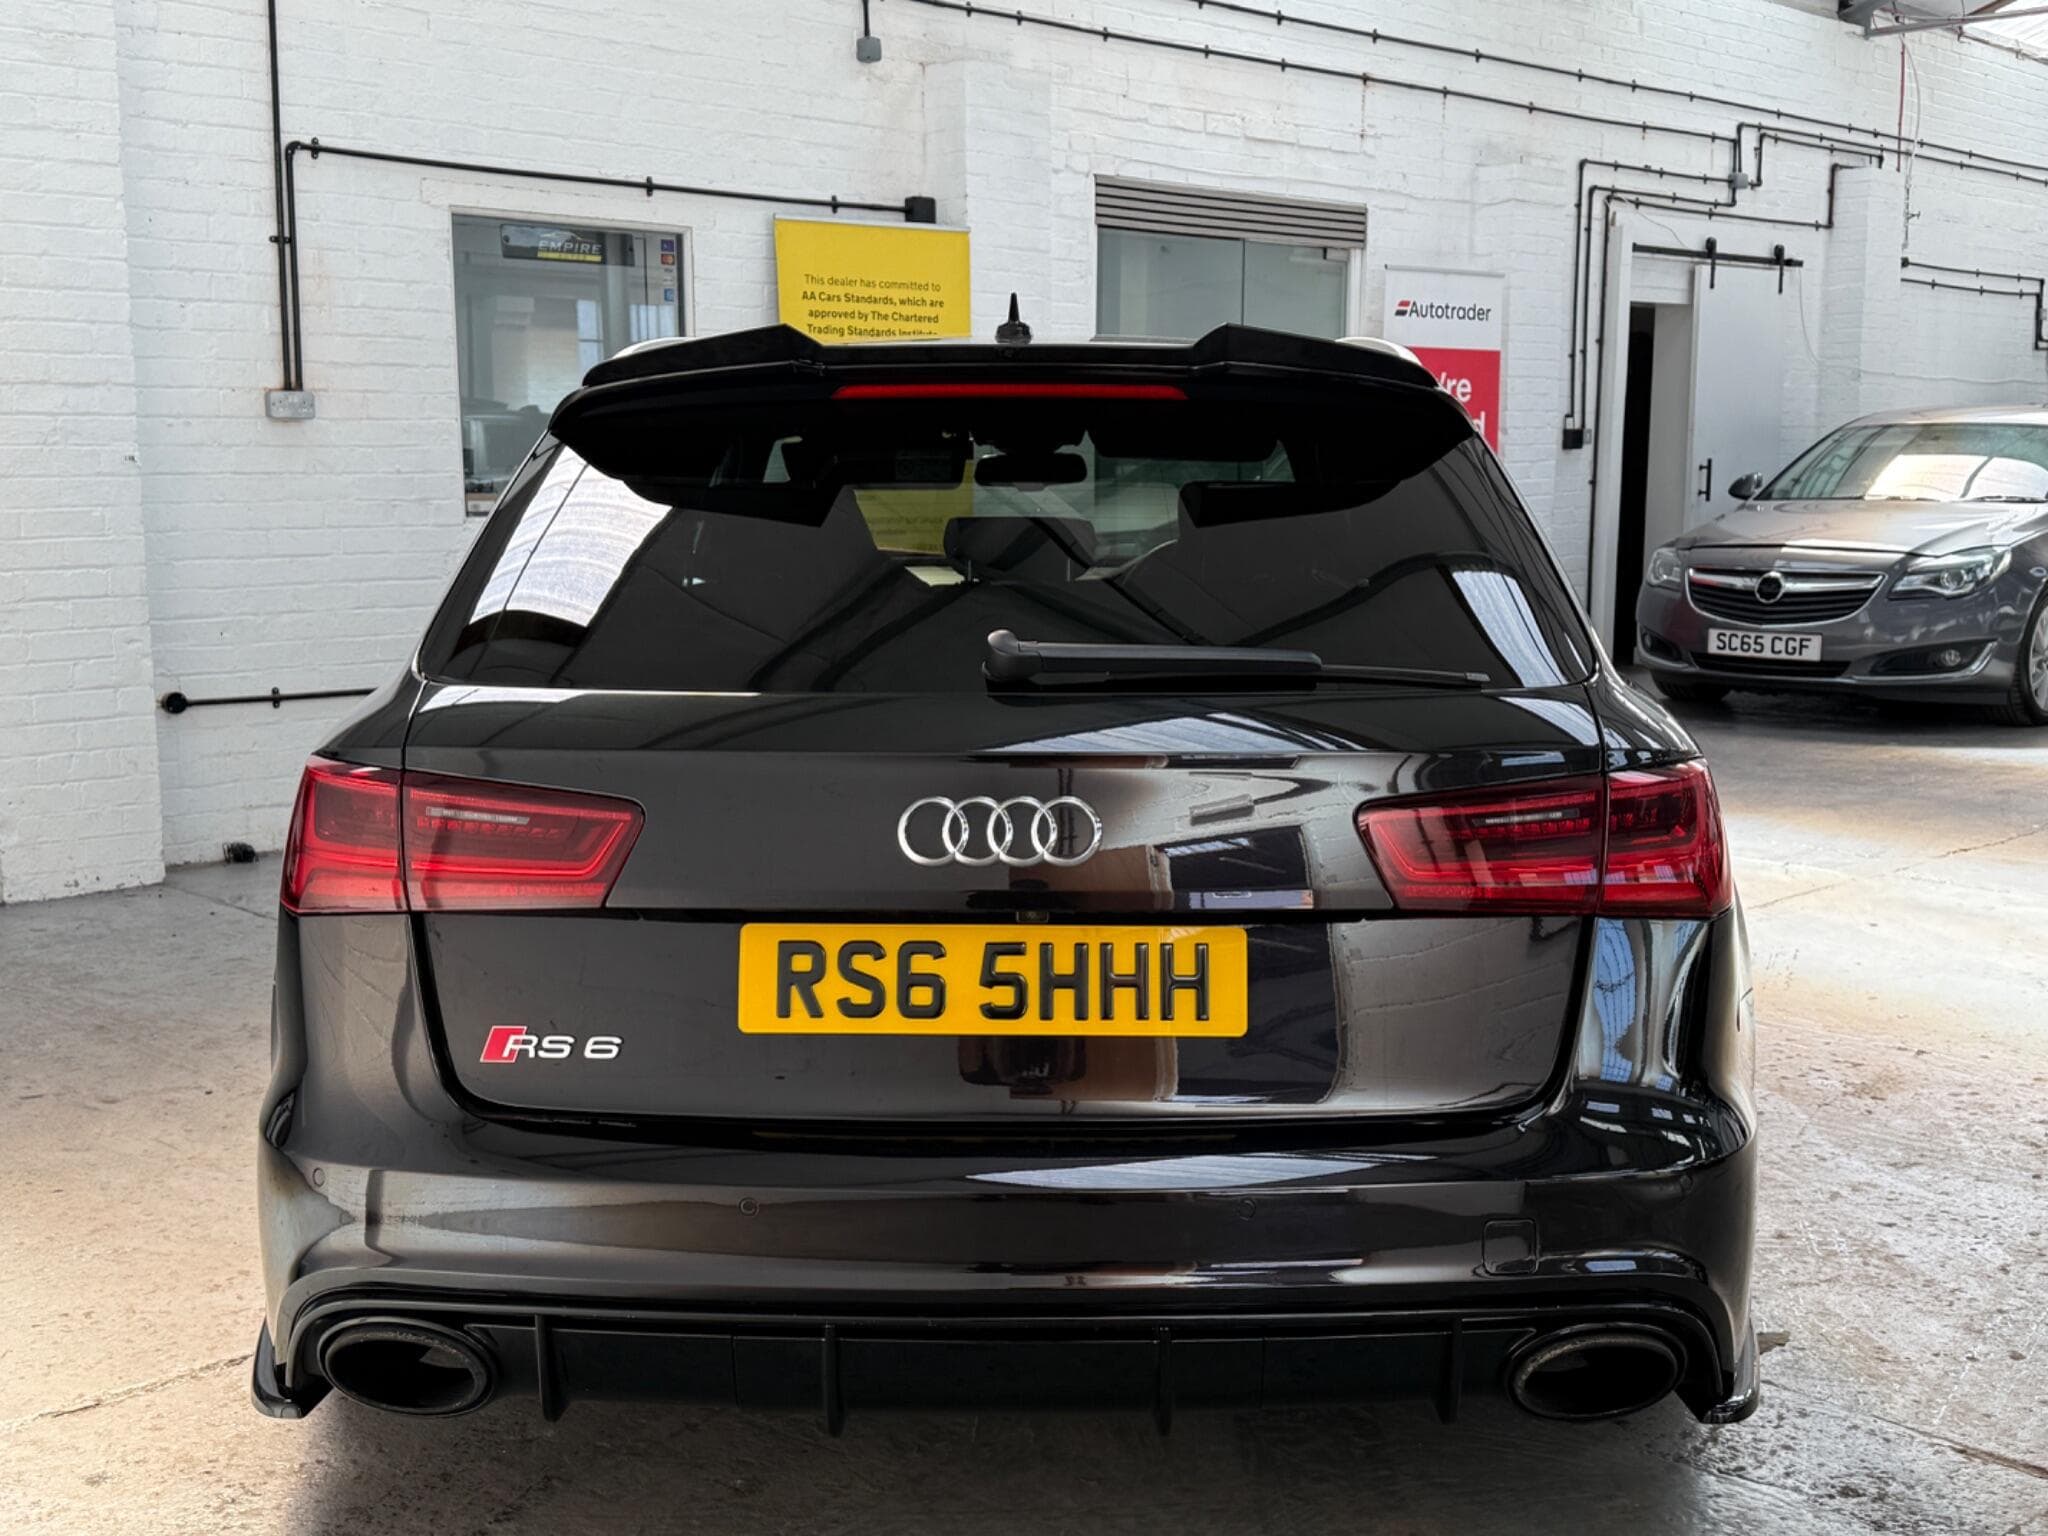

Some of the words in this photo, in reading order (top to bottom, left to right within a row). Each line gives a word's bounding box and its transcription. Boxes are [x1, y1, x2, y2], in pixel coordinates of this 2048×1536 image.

[539, 240, 602, 255] EMPIRE
[804, 274, 824, 285] This
[827, 276, 857, 287] dealer
[860, 278, 876, 288] has
[879, 280, 929, 292] committed
[931, 282, 941, 292] to
[802, 291, 816, 301] AA
[819, 292, 841, 302] Cars
[844, 293, 897, 306] Standards,
[899, 296, 927, 307] which
[929, 299, 944, 308] are
[808, 309, 855, 319] approved
[858, 310, 868, 321] by
[871, 311, 889, 321] The
[891, 312, 939, 323] Chartered
[1408, 301, 1491, 321] Autotrader
[807, 324, 845, 336] Trading
[847, 325, 896, 337] Standards
[1716, 632, 1764, 654] SC65
[1770, 636, 1812, 656] CGF
[776, 940, 947, 1019] RS6
[979, 941, 1210, 1021] 5HHH
[502, 1034, 575, 1059] RS
[584, 1035, 622, 1059] 6
